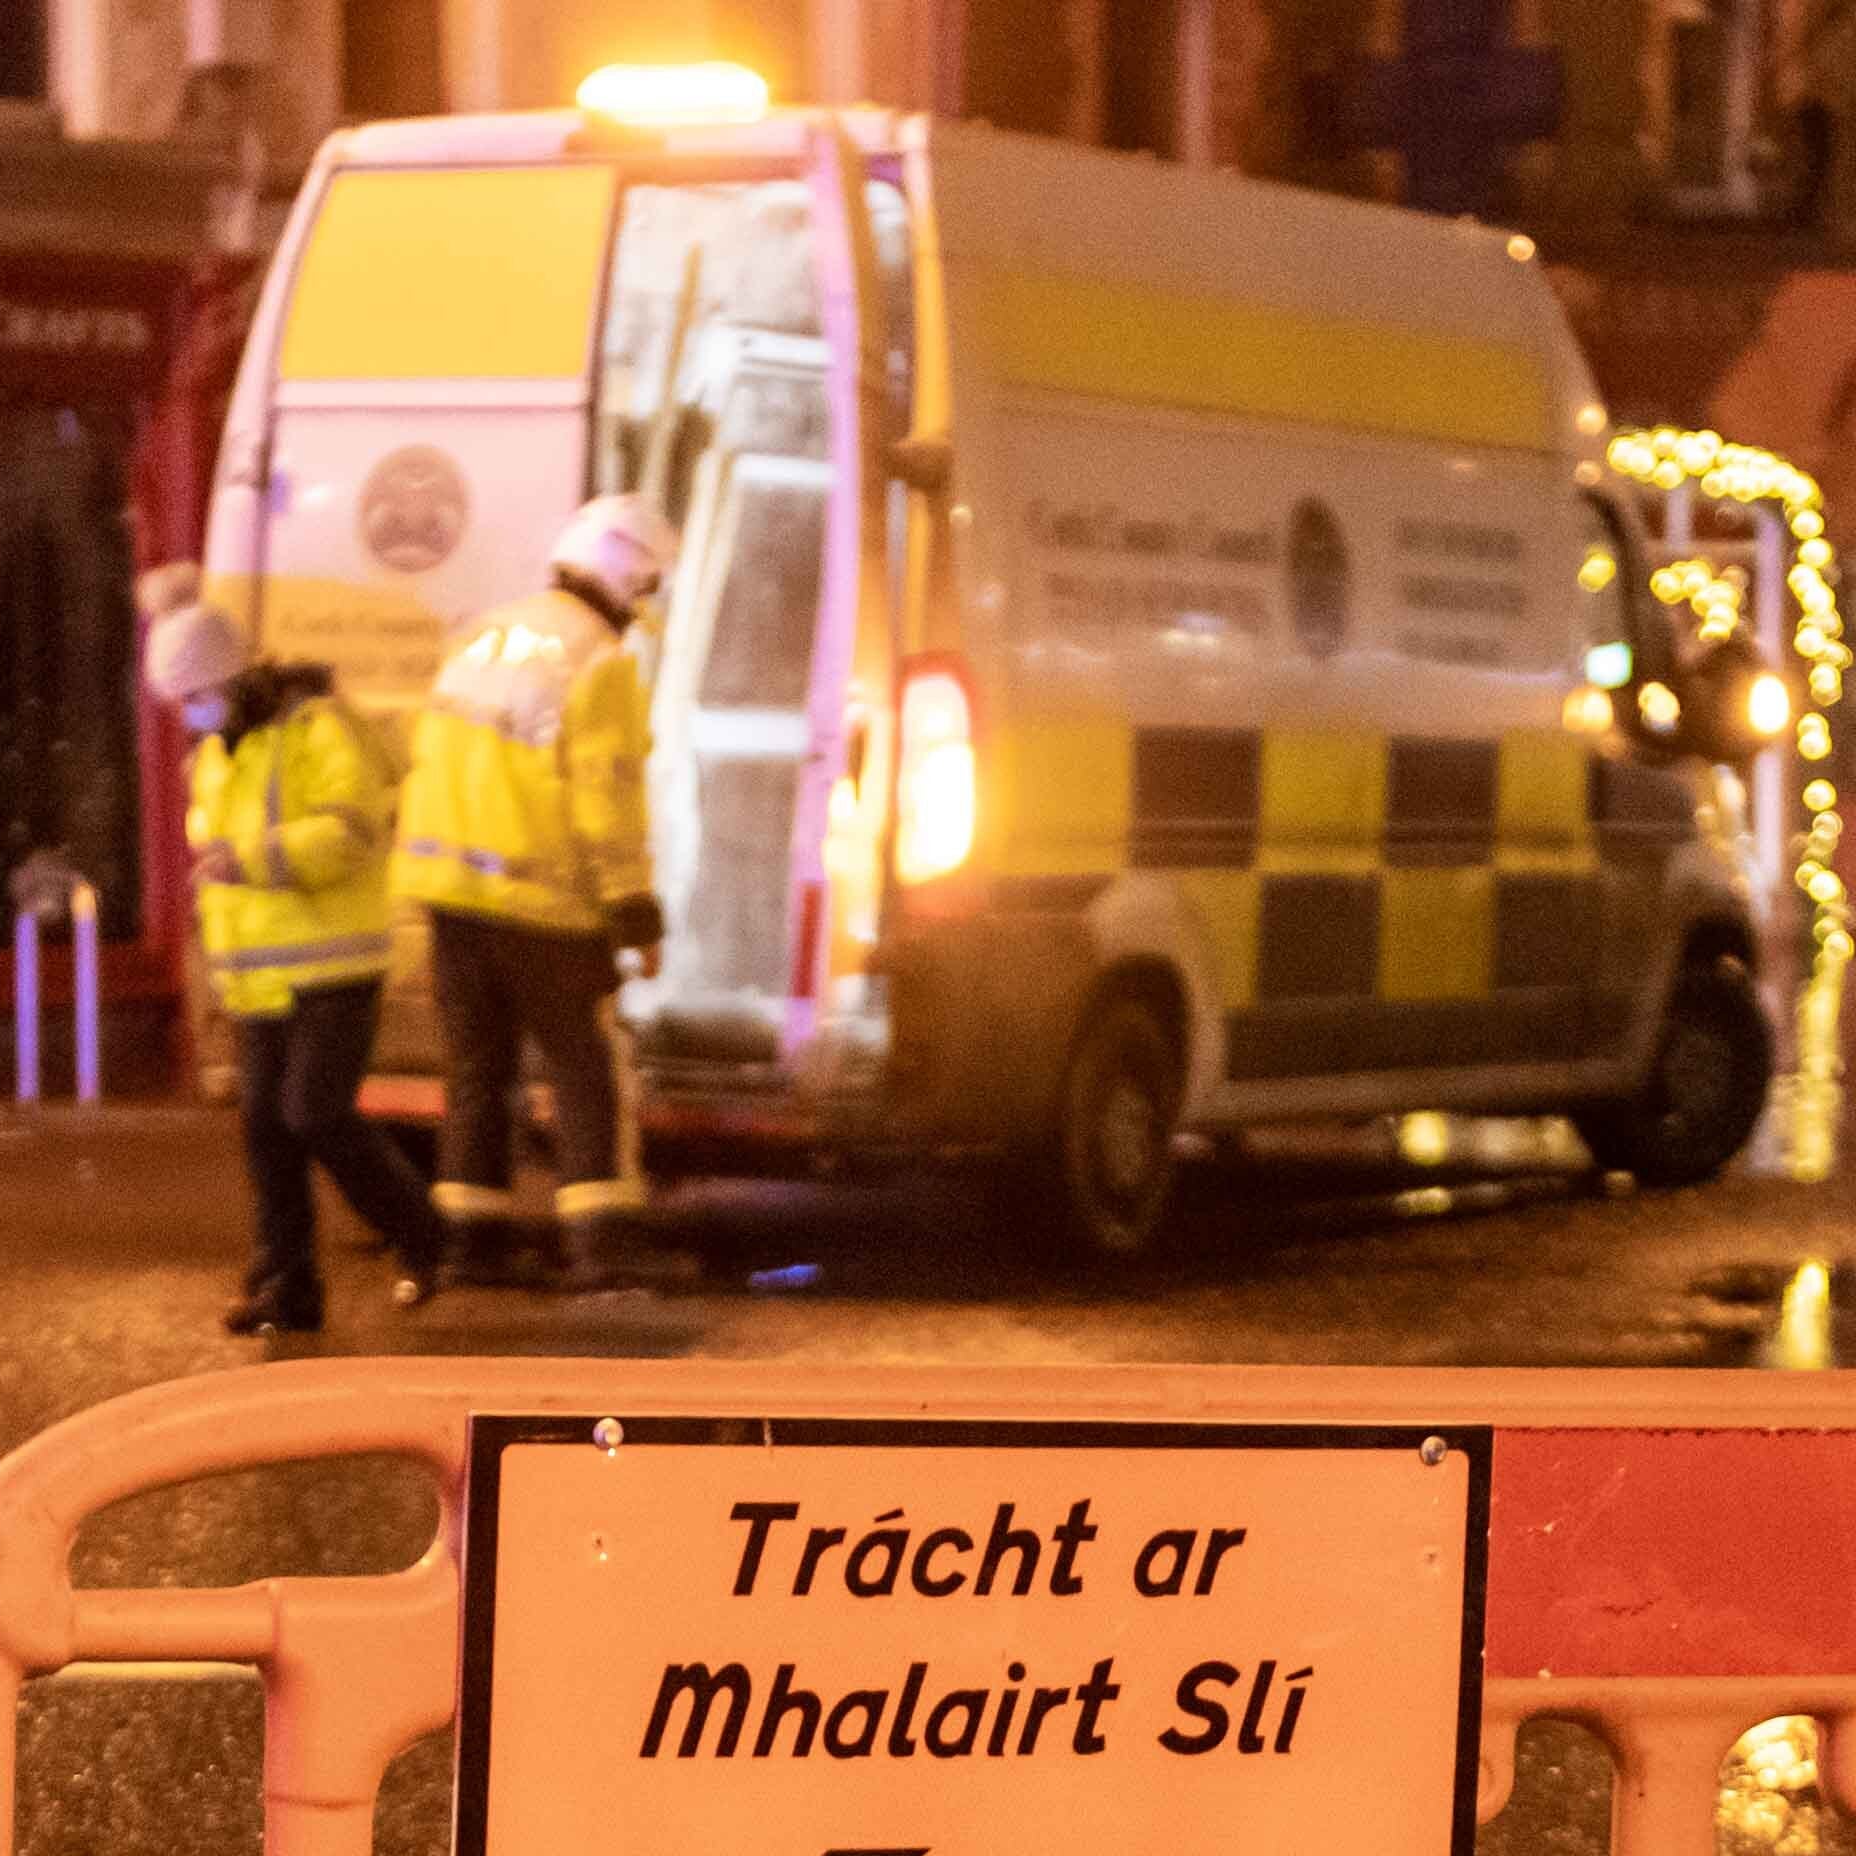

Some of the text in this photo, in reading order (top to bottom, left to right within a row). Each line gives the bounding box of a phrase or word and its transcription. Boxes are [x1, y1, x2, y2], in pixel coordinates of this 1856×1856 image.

[732, 1501, 1244, 1597] Trácht ar
[641, 1660, 1312, 1758] Mhalairt Slí
